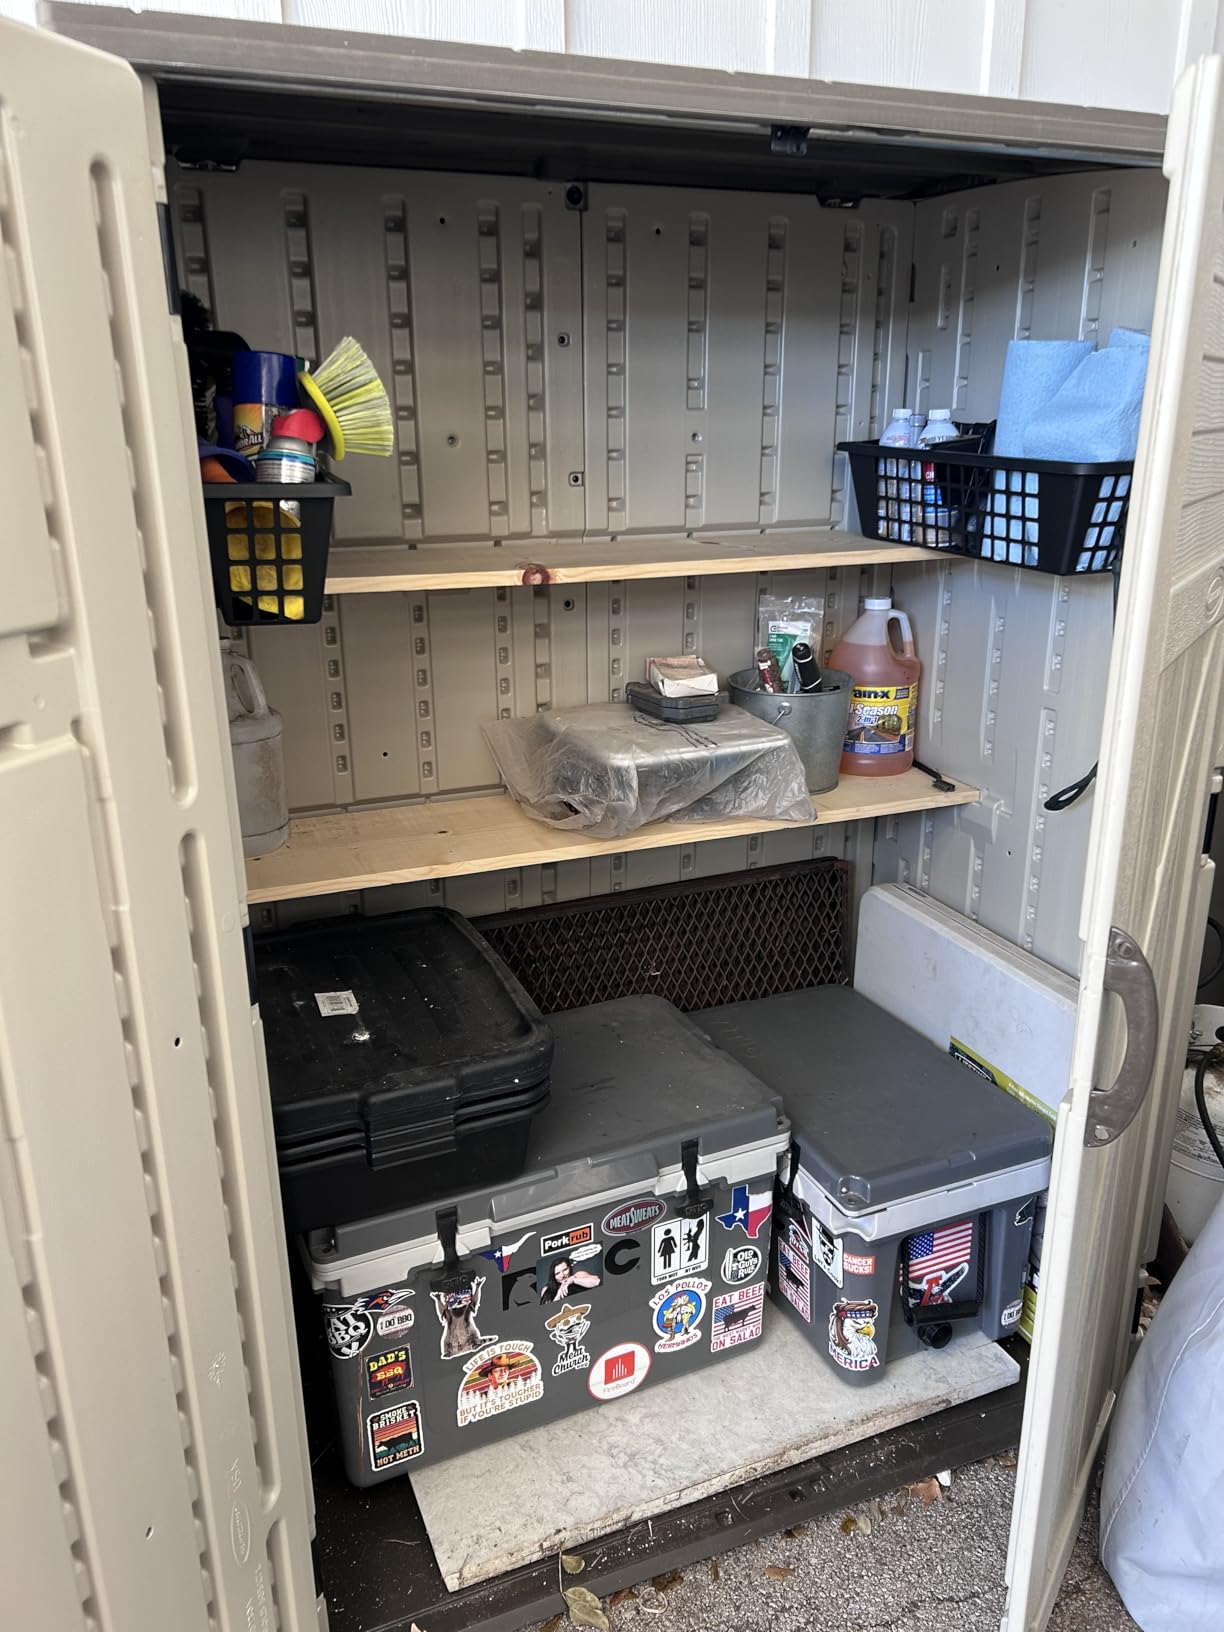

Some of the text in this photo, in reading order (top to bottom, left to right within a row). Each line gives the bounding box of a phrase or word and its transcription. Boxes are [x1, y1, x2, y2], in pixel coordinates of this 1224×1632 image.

[852, 689, 890, 699] ain-x
[545, 1231, 589, 1250] Pork rub
[737, 1250, 754, 1261] OLD
[792, 1254, 808, 1276] BEEF
[844, 1253, 873, 1265] CANCER
[738, 1265, 756, 1278] RULE
[653, 1281, 708, 1306] LOS POLLOS
[715, 1283, 763, 1308] EAT BEEF
[385, 1319, 395, 1328] DO
[712, 1327, 760, 1351] ON SALAD
[369, 1351, 406, 1371] DAD'S
[465, 1343, 531, 1372] LIFE IS TOUGH
[553, 1354, 589, 1375] Church
[376, 1366, 403, 1380] BBQ
[460, 1406, 477, 1417] BUT
[499, 1383, 541, 1400] TOUGHER
[460, 1390, 541, 1425] IF YOU'RE STUPID
[372, 1410, 416, 1431] BRISKET
[380, 1406, 407, 1421] SMOKE
[377, 1445, 420, 1467] NOT METH
